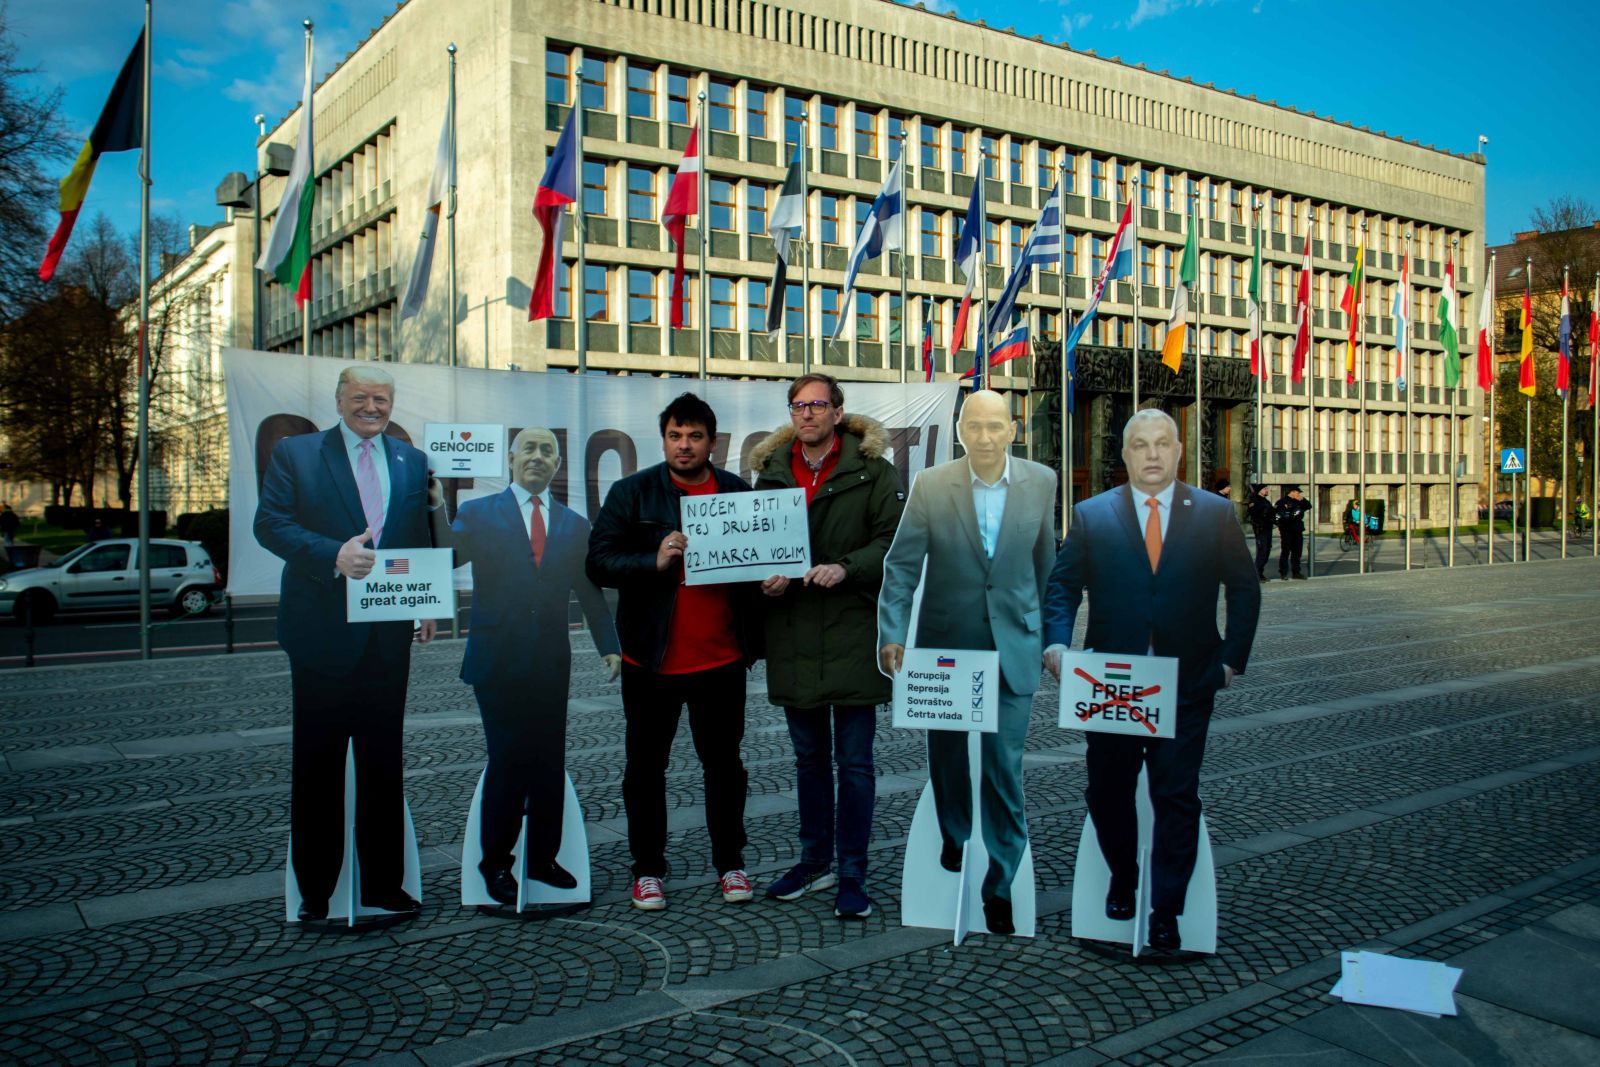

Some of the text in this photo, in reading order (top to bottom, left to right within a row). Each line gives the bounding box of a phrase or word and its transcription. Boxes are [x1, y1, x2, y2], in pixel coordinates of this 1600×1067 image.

[450, 430, 454, 440] I
[430, 442, 495, 453] GENOCIDE
[687, 494, 802, 518] NOČEM BITI V
[686, 523, 709, 536] TEJ
[686, 546, 806, 568] 22. MARCA VOLIM
[366, 582, 432, 593] Make war
[360, 593, 441, 609] great again.
[907, 670, 951, 682] Korupcija
[907, 683, 950, 695] Represija
[1092, 683, 1145, 703] FREE
[907, 696, 953, 707] Sovraštvo
[906, 708, 963, 720] Četrta vlada
[1074, 701, 1160, 724] SPEECH
